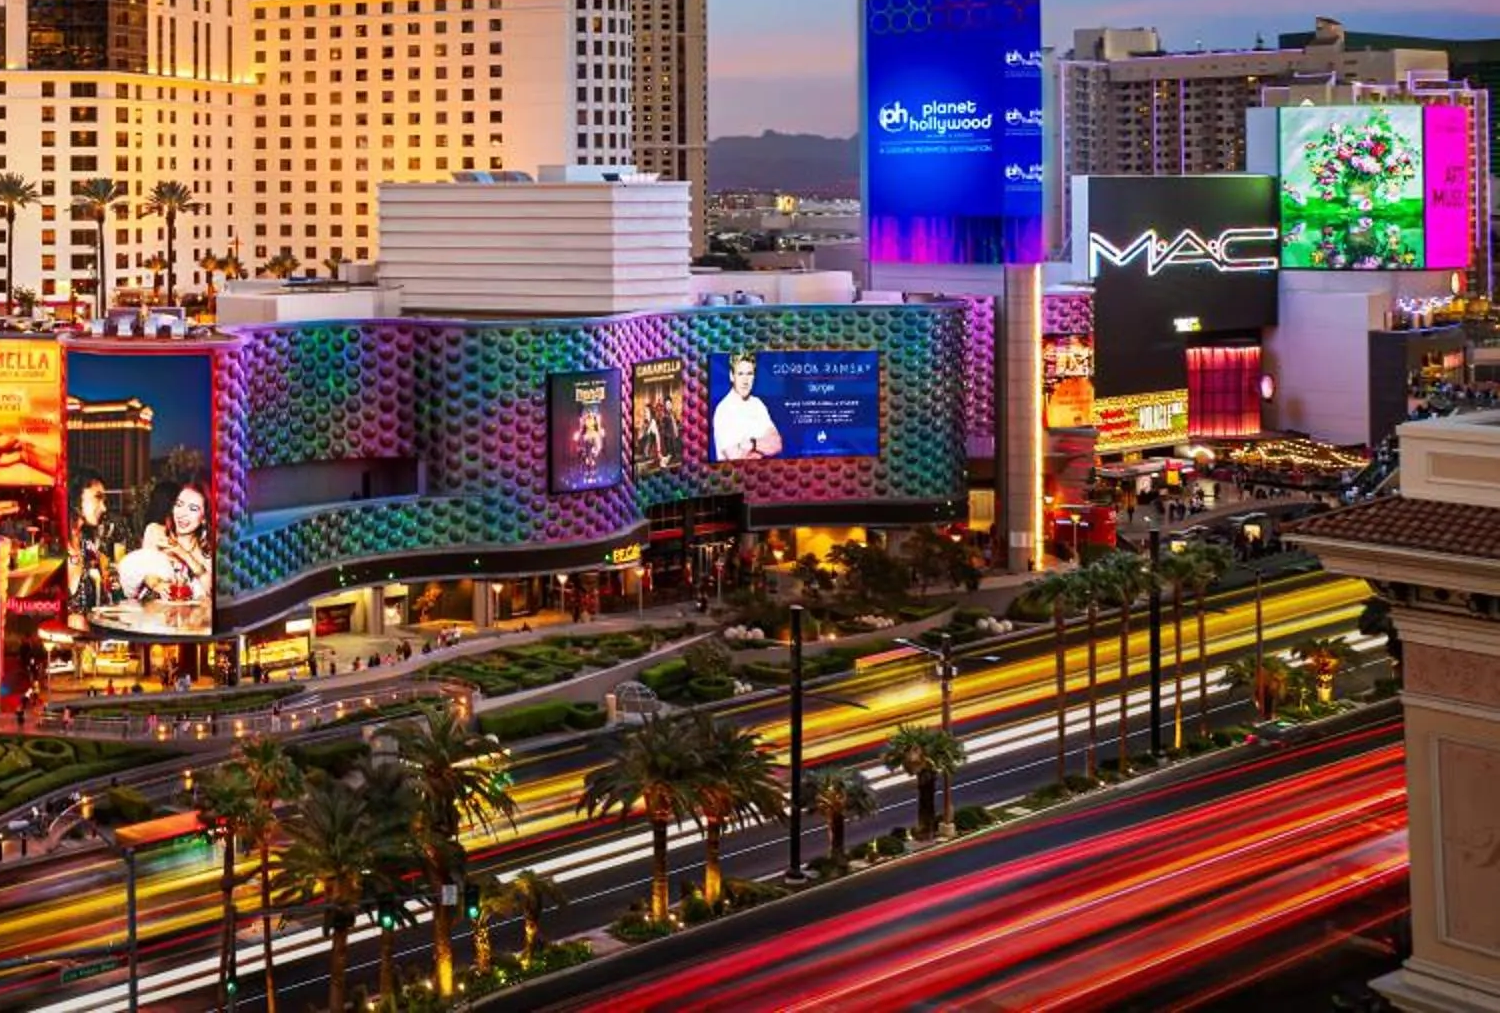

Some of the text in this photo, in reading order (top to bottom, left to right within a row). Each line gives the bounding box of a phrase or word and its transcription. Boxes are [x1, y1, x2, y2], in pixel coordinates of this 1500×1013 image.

[881, 101, 908, 127] ph
[923, 100, 977, 118] planet
[909, 113, 994, 134] hollywood
